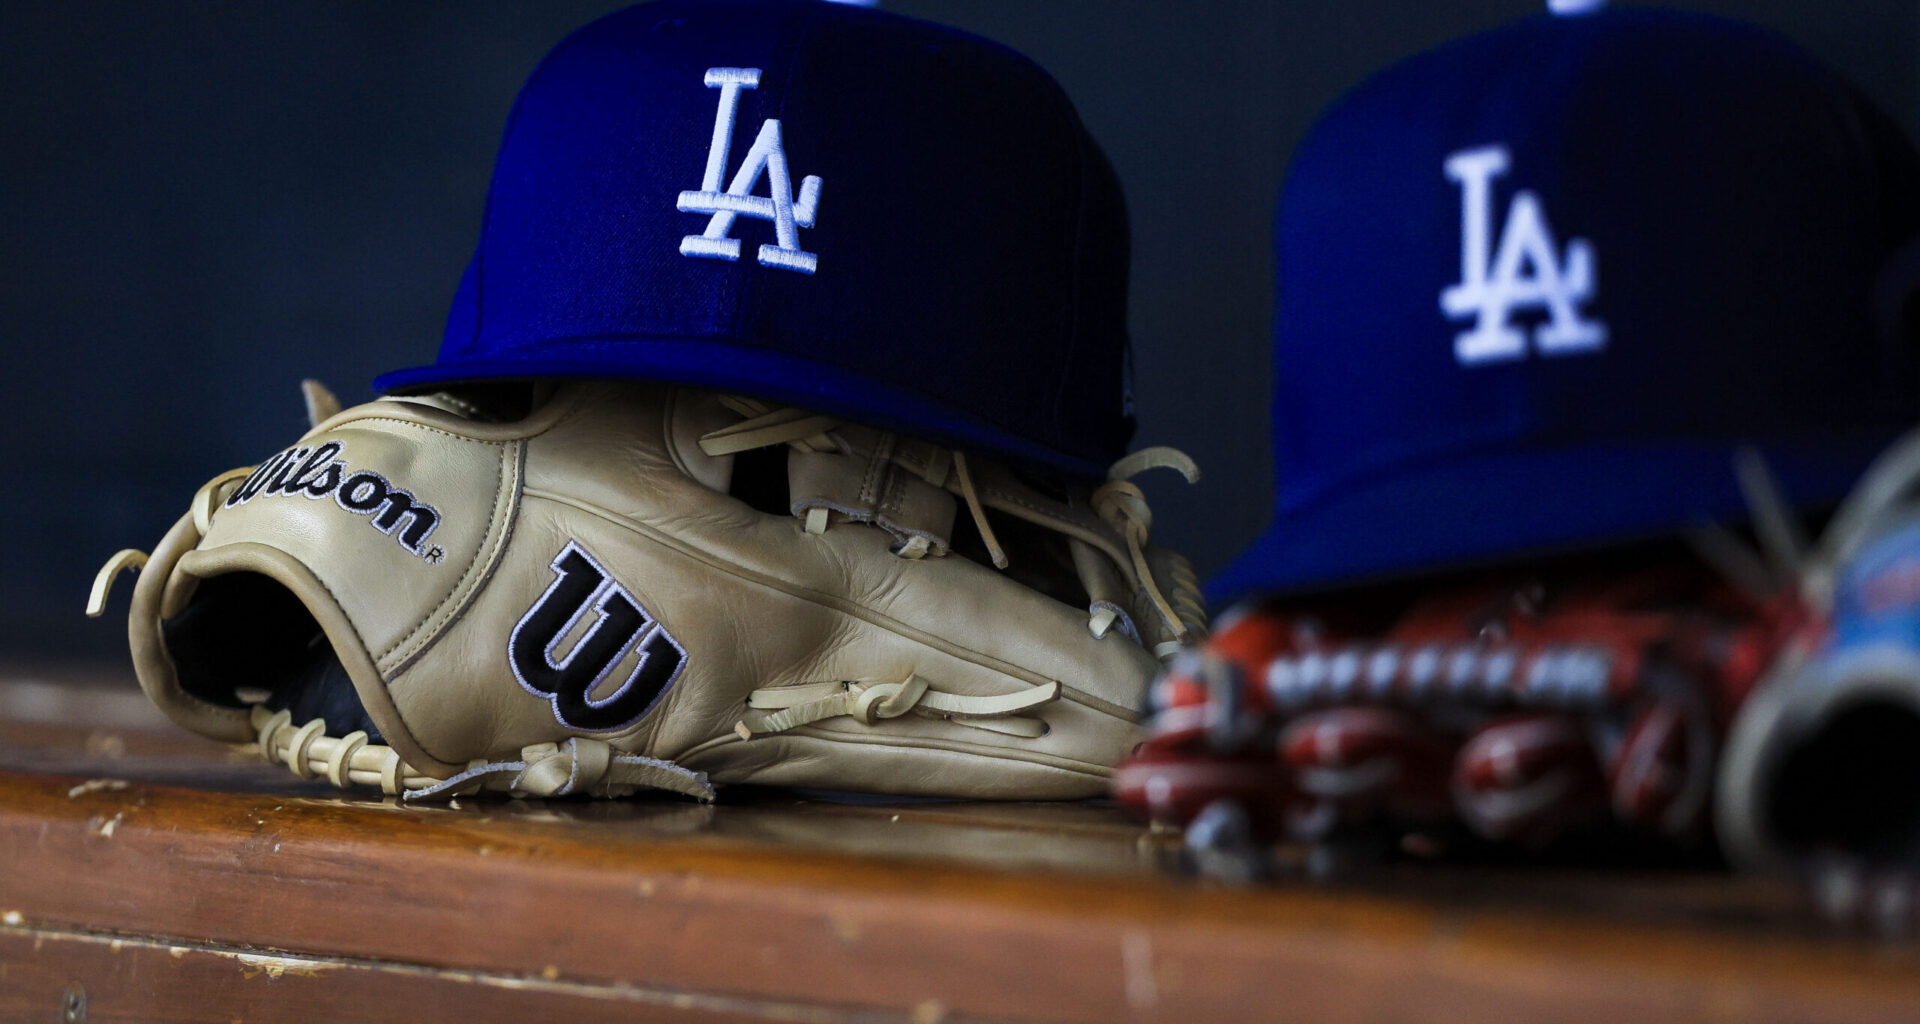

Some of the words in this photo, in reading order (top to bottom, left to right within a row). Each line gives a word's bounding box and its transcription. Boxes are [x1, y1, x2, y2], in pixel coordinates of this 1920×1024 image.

[676, 67, 824, 275] LA
[1438, 145, 1608, 366] LA
[223, 440, 441, 557] Wilson
[508, 540, 689, 734] W
